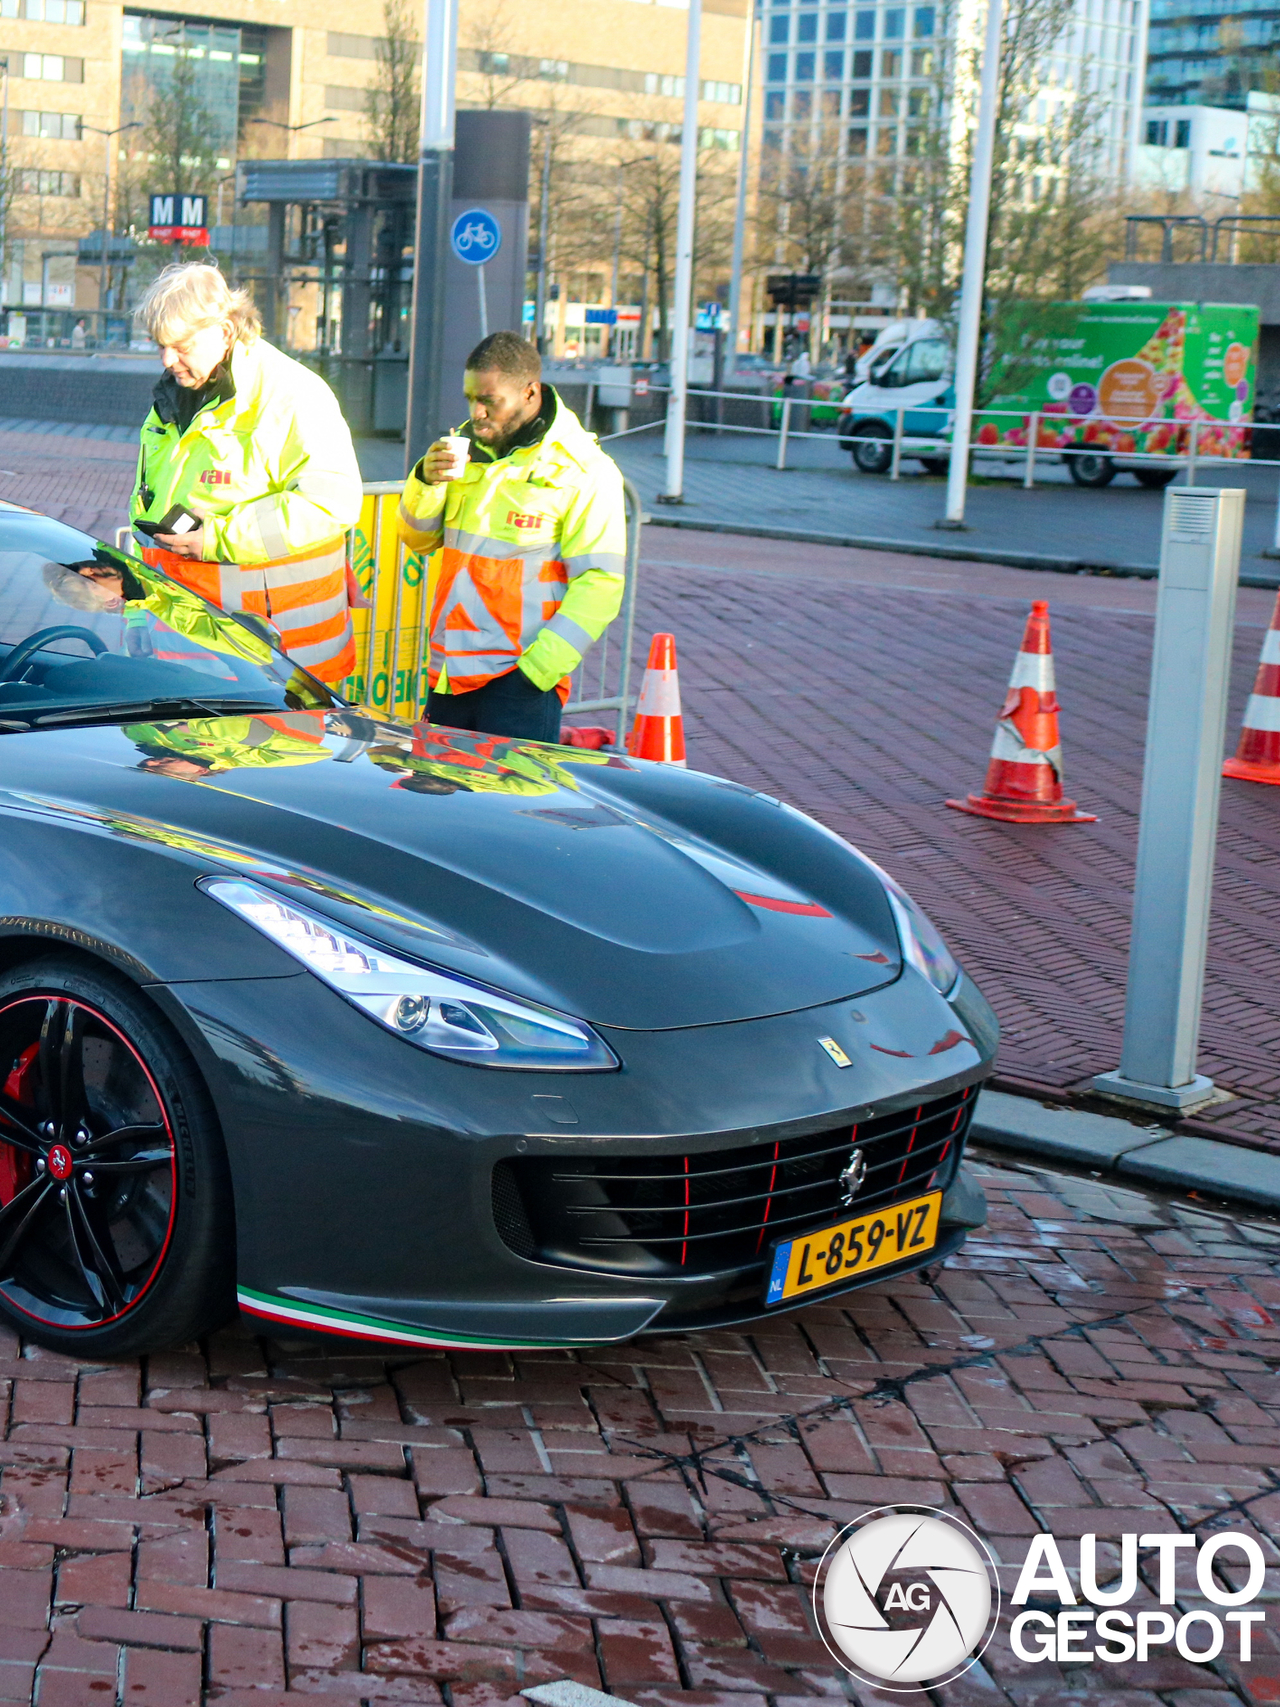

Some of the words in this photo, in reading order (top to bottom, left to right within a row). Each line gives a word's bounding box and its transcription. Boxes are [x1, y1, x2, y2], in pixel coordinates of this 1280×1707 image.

[153, 196, 174, 225] M
[181, 197, 204, 226] M
[199, 469, 232, 485] rai
[506, 510, 543, 529] rai
[174, 1102, 196, 1196] MICHELIN
[797, 1203, 931, 1286] L-859-VZ
[769, 1277, 783, 1293] NL
